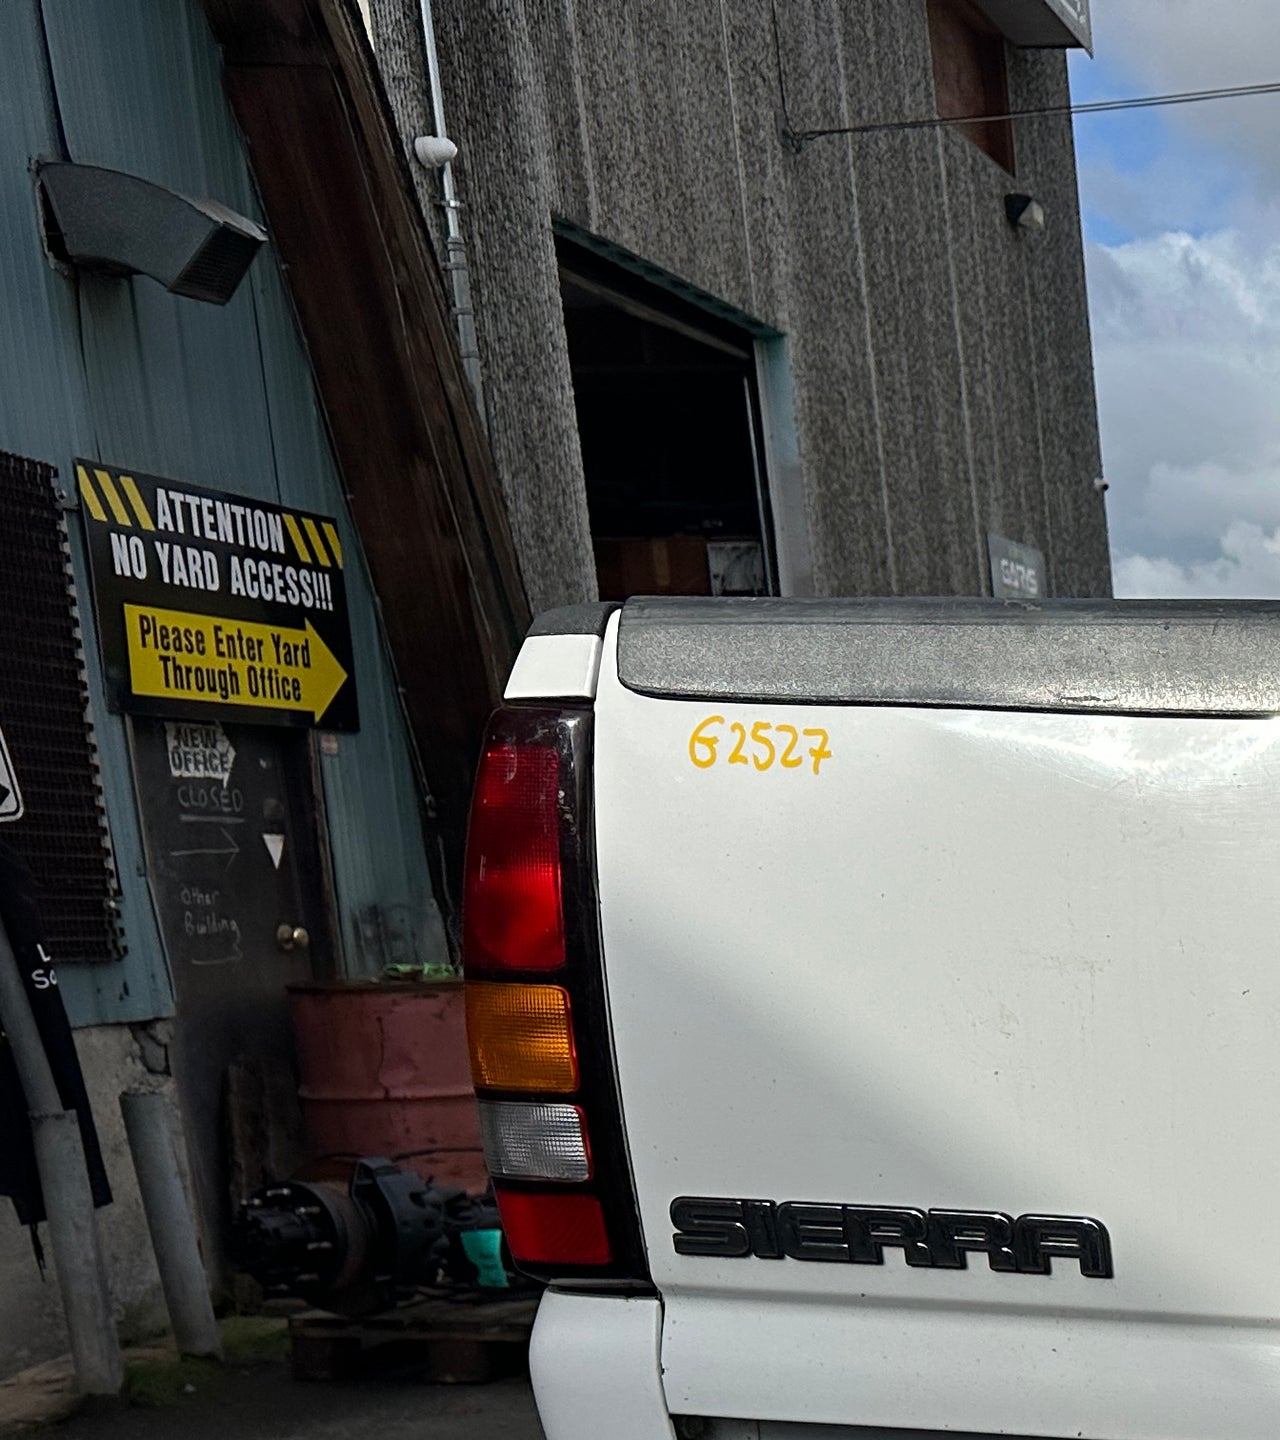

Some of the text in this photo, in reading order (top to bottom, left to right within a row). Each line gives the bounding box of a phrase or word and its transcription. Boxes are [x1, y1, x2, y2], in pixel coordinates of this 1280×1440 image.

[156, 487, 286, 554] ATTENTION
[110, 532, 334, 612] NO YARD ACCESS!!!
[138, 614, 312, 669] Please Enter Yard
[158, 655, 302, 702] Through Office
[171, 745, 230, 775] OFFICE
[173, 725, 217, 749] NEW
[689, 715, 833, 775] G2527
[177, 785, 243, 812] CLOSED
[669, 1196, 1114, 1279] SIERRA
